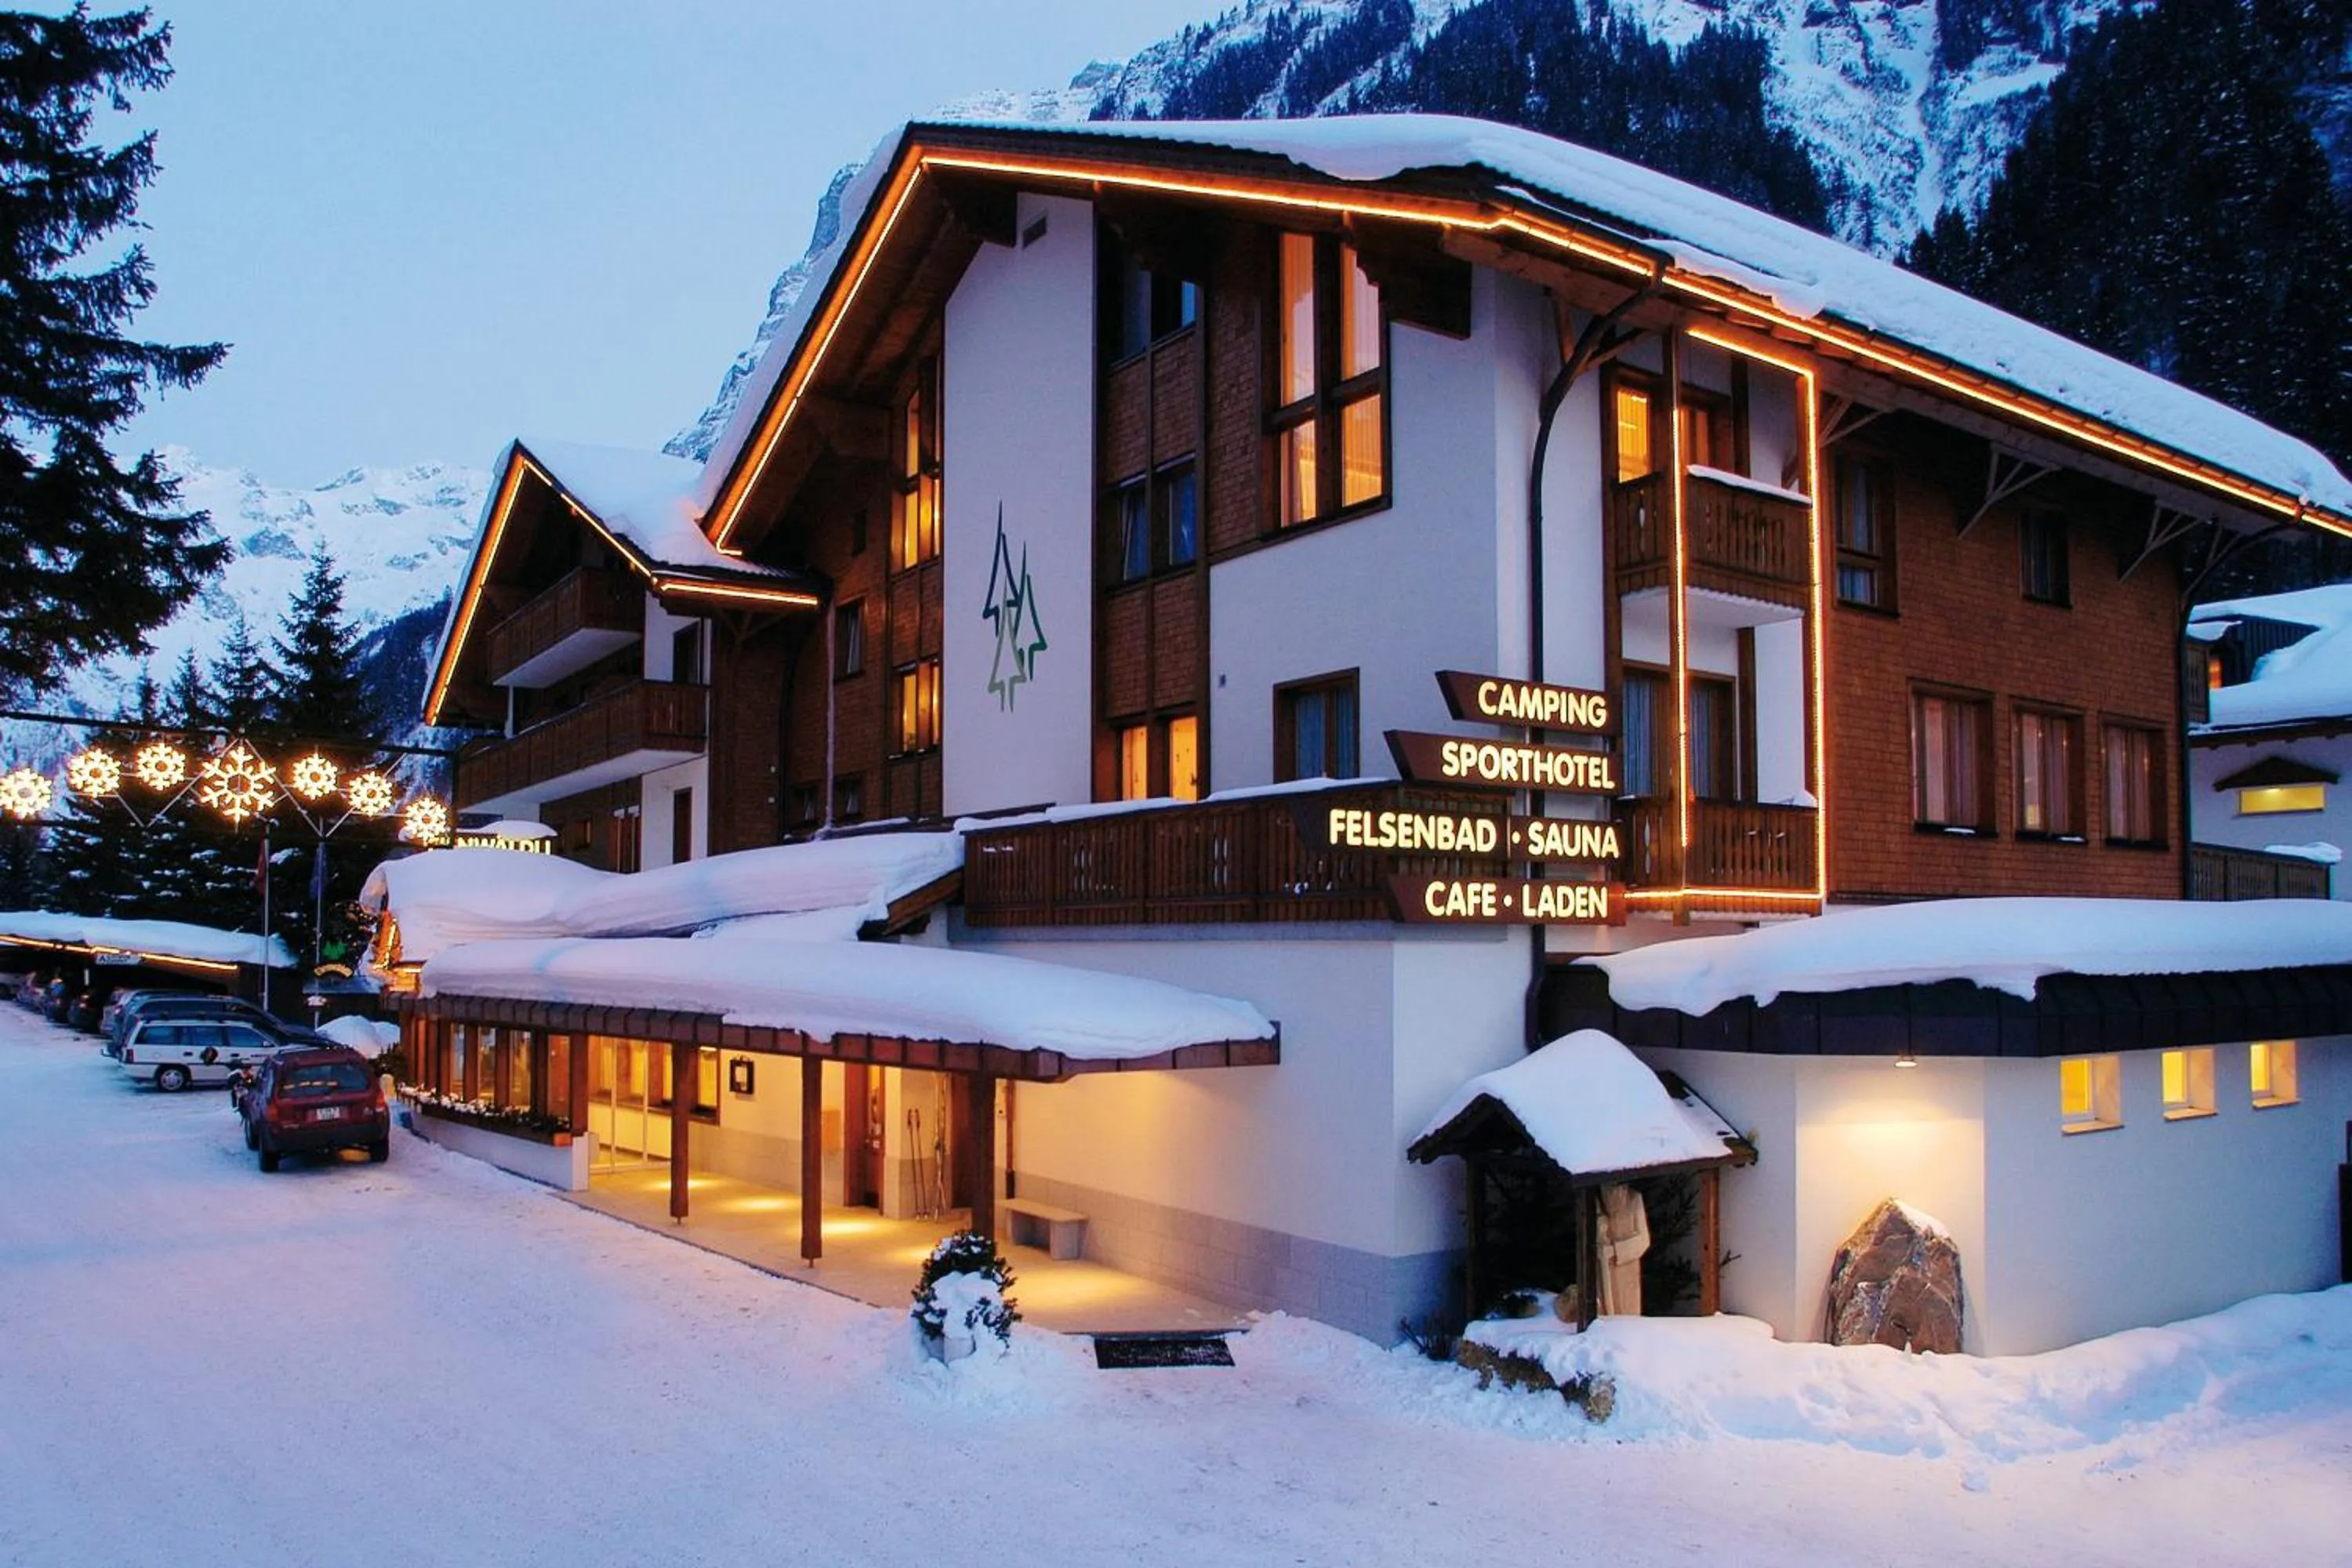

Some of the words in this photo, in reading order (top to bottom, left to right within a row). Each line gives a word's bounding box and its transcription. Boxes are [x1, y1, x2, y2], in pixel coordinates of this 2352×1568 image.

[1478, 681, 1607, 728] CAMPING
[1441, 740, 1616, 789] SPORTHOTEL
[1330, 808, 1497, 853] FELSENBAD
[1527, 821, 1620, 859] SAUNA
[1425, 880, 1497, 917] CAFE
[1522, 883, 1609, 919] LADEN
